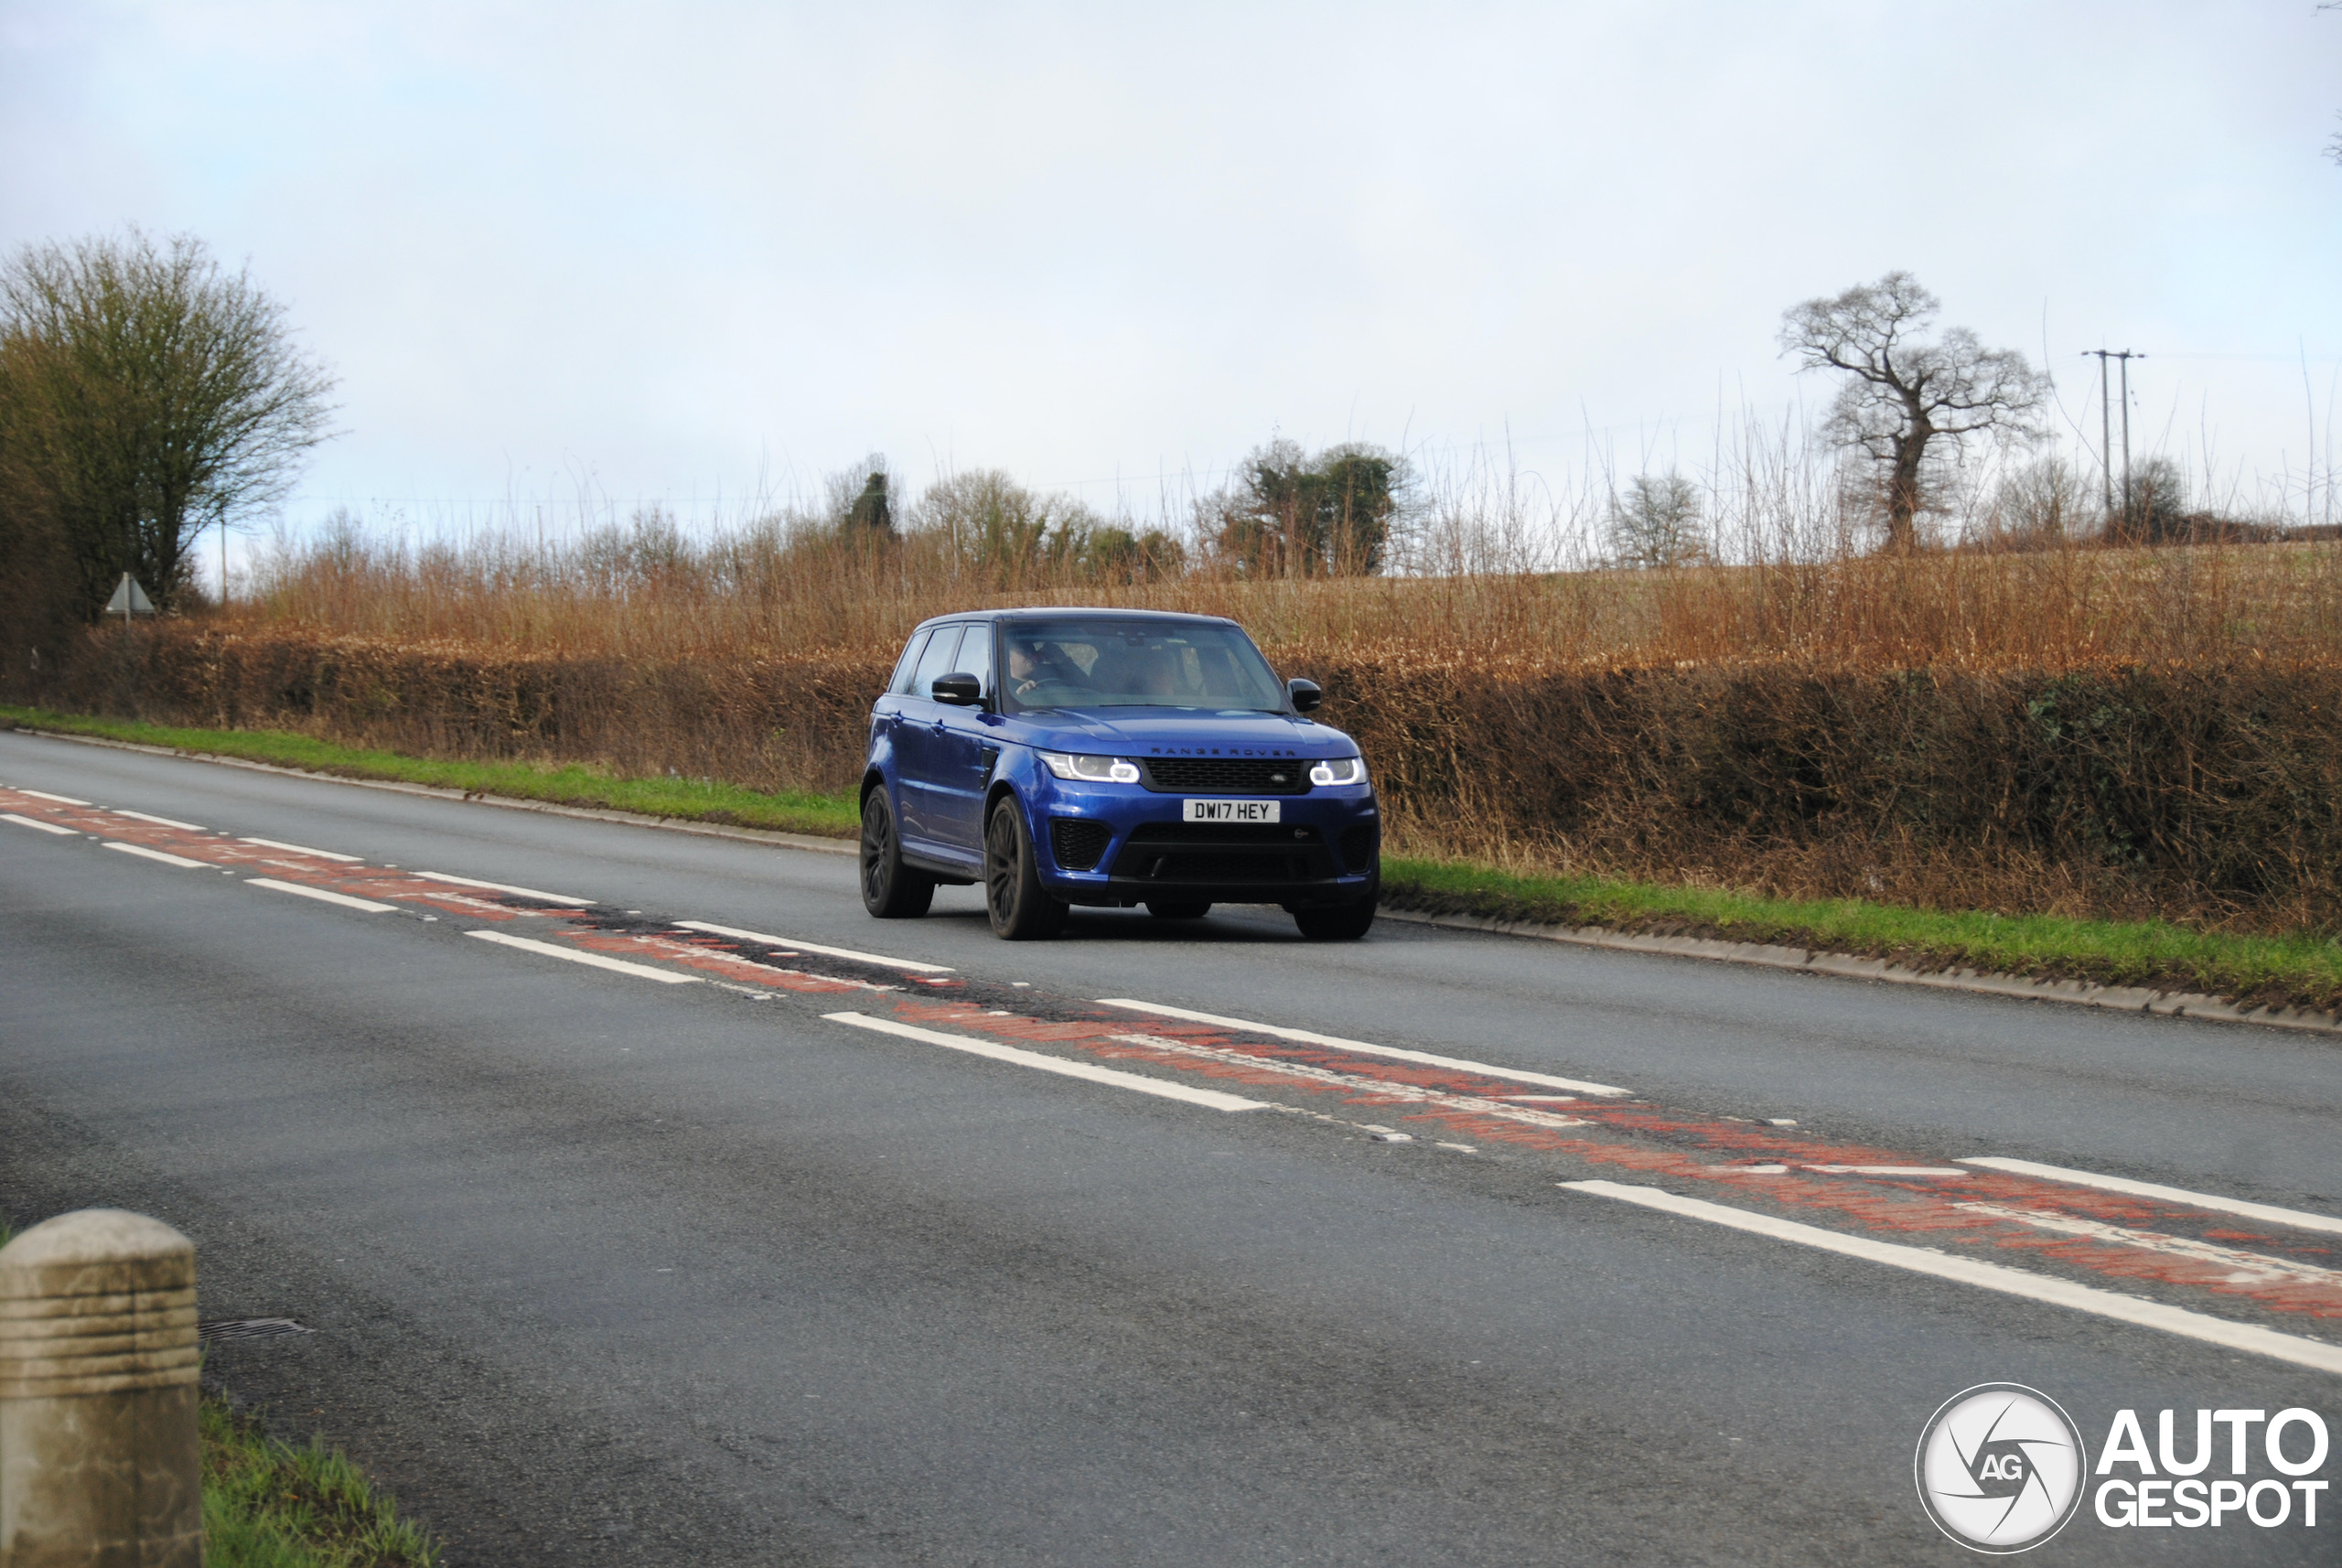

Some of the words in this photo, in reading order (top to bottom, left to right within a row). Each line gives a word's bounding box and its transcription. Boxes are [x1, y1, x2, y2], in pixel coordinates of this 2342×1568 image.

[1150, 746, 1220, 756] RANGE
[1229, 747, 1296, 757] ROVER
[1194, 802, 1232, 819] DW17
[1237, 803, 1269, 820] HEY
